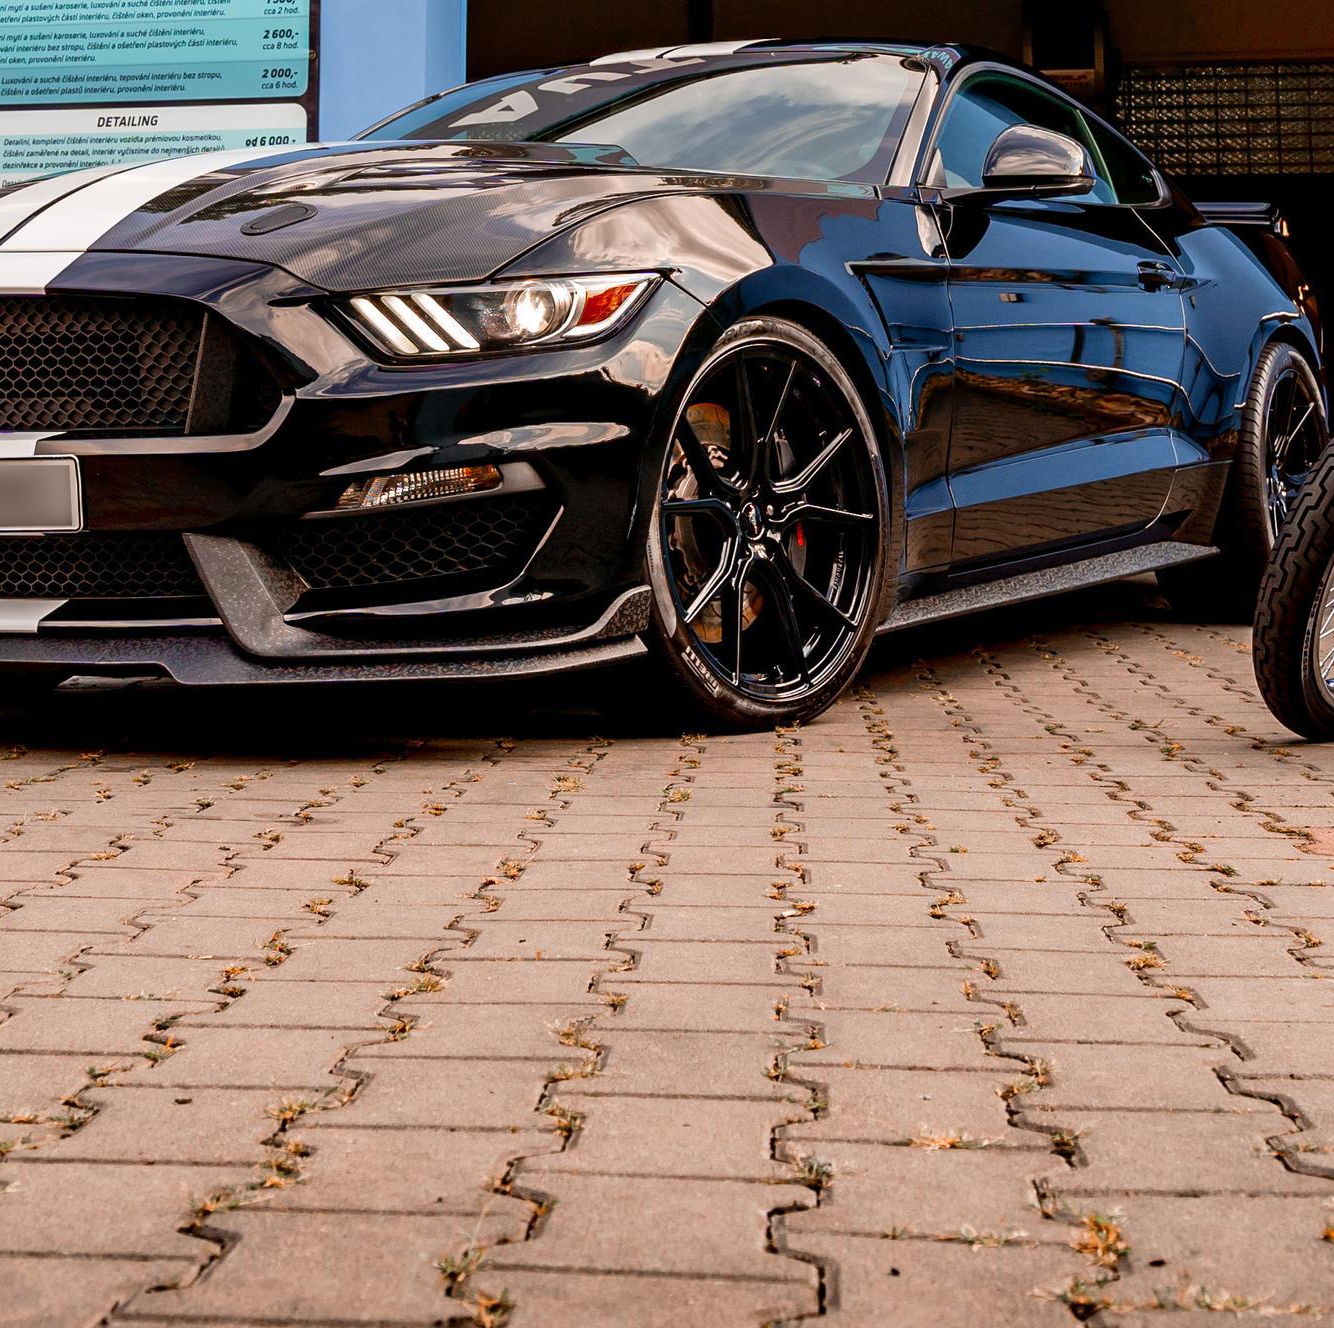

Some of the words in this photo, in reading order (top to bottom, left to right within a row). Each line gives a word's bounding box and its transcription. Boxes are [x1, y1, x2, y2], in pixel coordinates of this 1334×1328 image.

[7, 3, 25, 14] mytí
[30, 2, 54, 11] sušení
[54, 2, 89, 10] karoserie,
[90, 0, 121, 9] luxování
[126, 0, 149, 8] suché
[277, 6, 283, 15] 2
[283, 6, 300, 15] hod.
[20, 14, 60, 24] plastových
[60, 12, 79, 22] částí
[78, 13, 111, 21] interiéru,
[111, 11, 136, 20] čištění
[136, 11, 156, 19] oken,
[156, 9, 194, 20] provonění
[193, 8, 227, 17] interiéru.
[276, 41, 283, 50] 8
[282, 41, 299, 49] hod.
[261, 82, 274, 90] cca
[275, 80, 281, 89] 6
[281, 80, 298, 89] hod.
[97, 115, 159, 128] DETAILING
